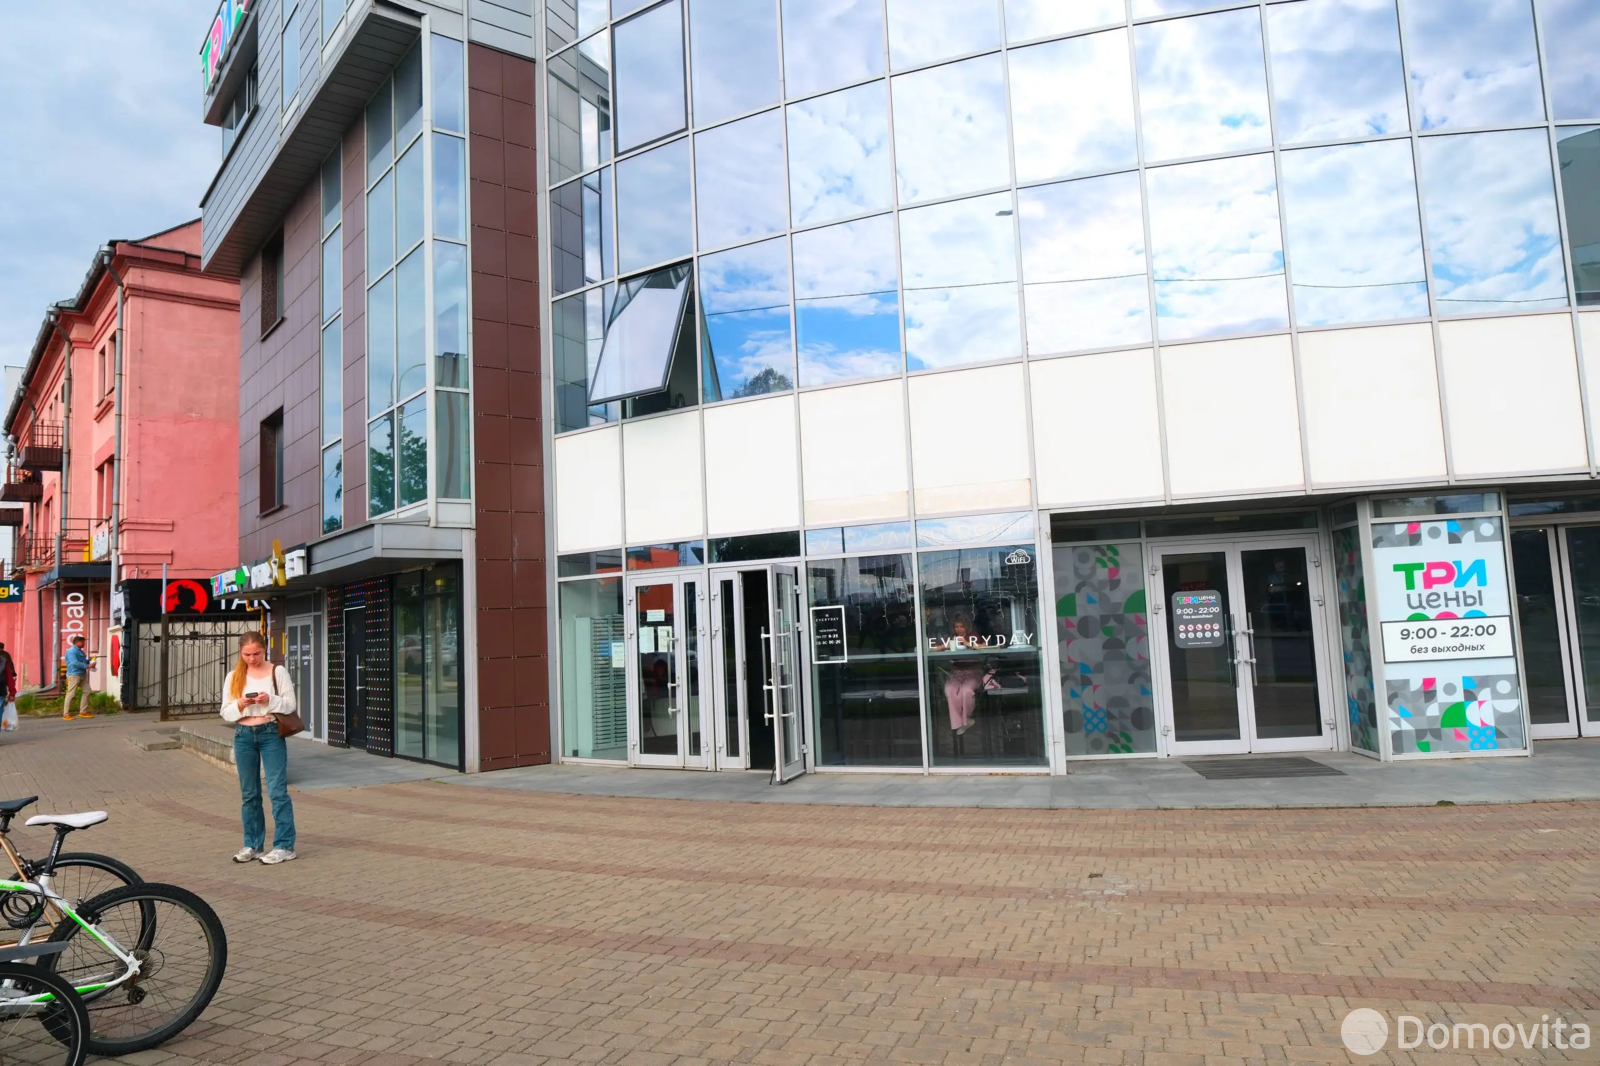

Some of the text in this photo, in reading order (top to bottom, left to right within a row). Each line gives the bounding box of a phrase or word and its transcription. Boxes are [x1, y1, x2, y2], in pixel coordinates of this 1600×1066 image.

[1393, 559, 1487, 590] ТРИ
[1177, 596, 1199, 604] ТРИ
[1407, 590, 1483, 610] цены
[1400, 627, 1437, 640] 9:00
[1450, 625, 1496, 637] 22:00
[928, 633, 1034, 649] EVERYDAY
[1410, 644, 1485, 654] без выходных
